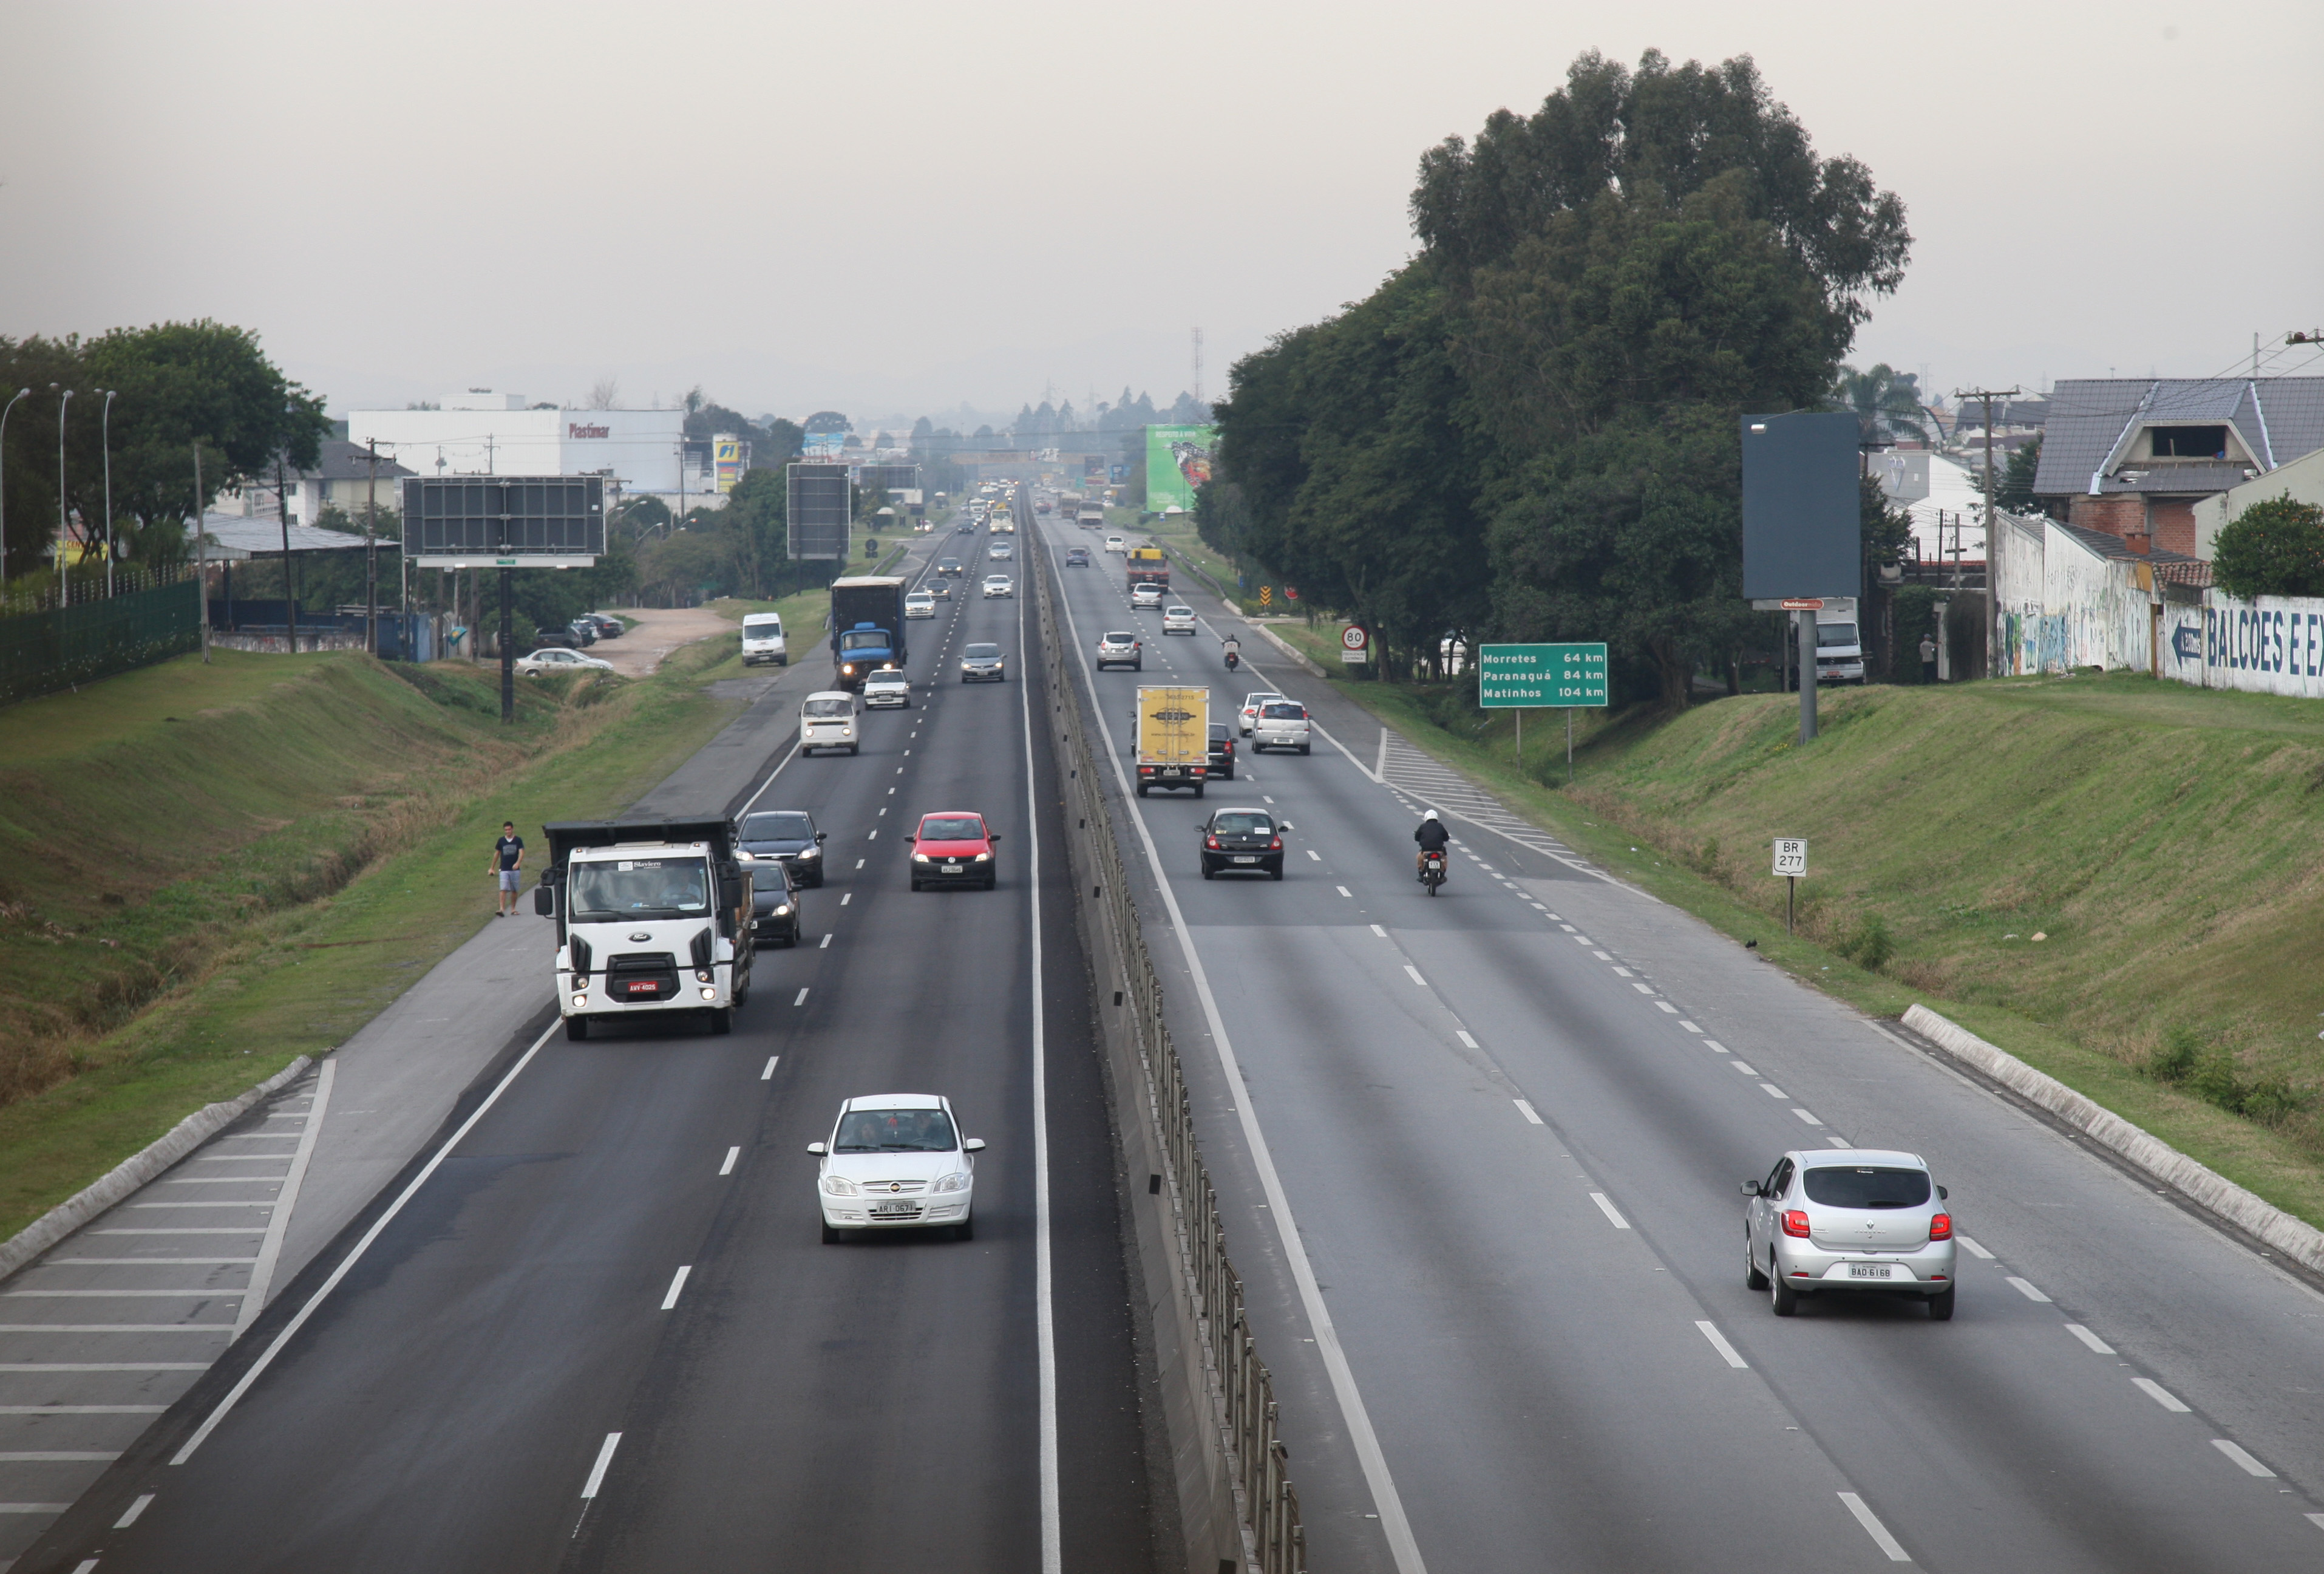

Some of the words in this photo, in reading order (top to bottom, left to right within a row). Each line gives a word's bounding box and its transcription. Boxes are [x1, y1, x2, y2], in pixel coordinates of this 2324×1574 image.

[1347, 633, 1361, 641] 80
[2290, 613, 2300, 675] E
[1484, 655, 1537, 663] Morretes
[1564, 653, 1580, 663] 64
[1586, 653, 1603, 662] km
[1484, 669, 1551, 683] Paranaguá
[1564, 671, 1580, 680] 84
[1586, 670, 1603, 679] km
[1484, 689, 1541, 697] Matinhos
[1560, 688, 1581, 697] 104
[1586, 688, 1603, 697] km
[1784, 842, 1798, 853] BR
[1779, 856, 1802, 866] 277
